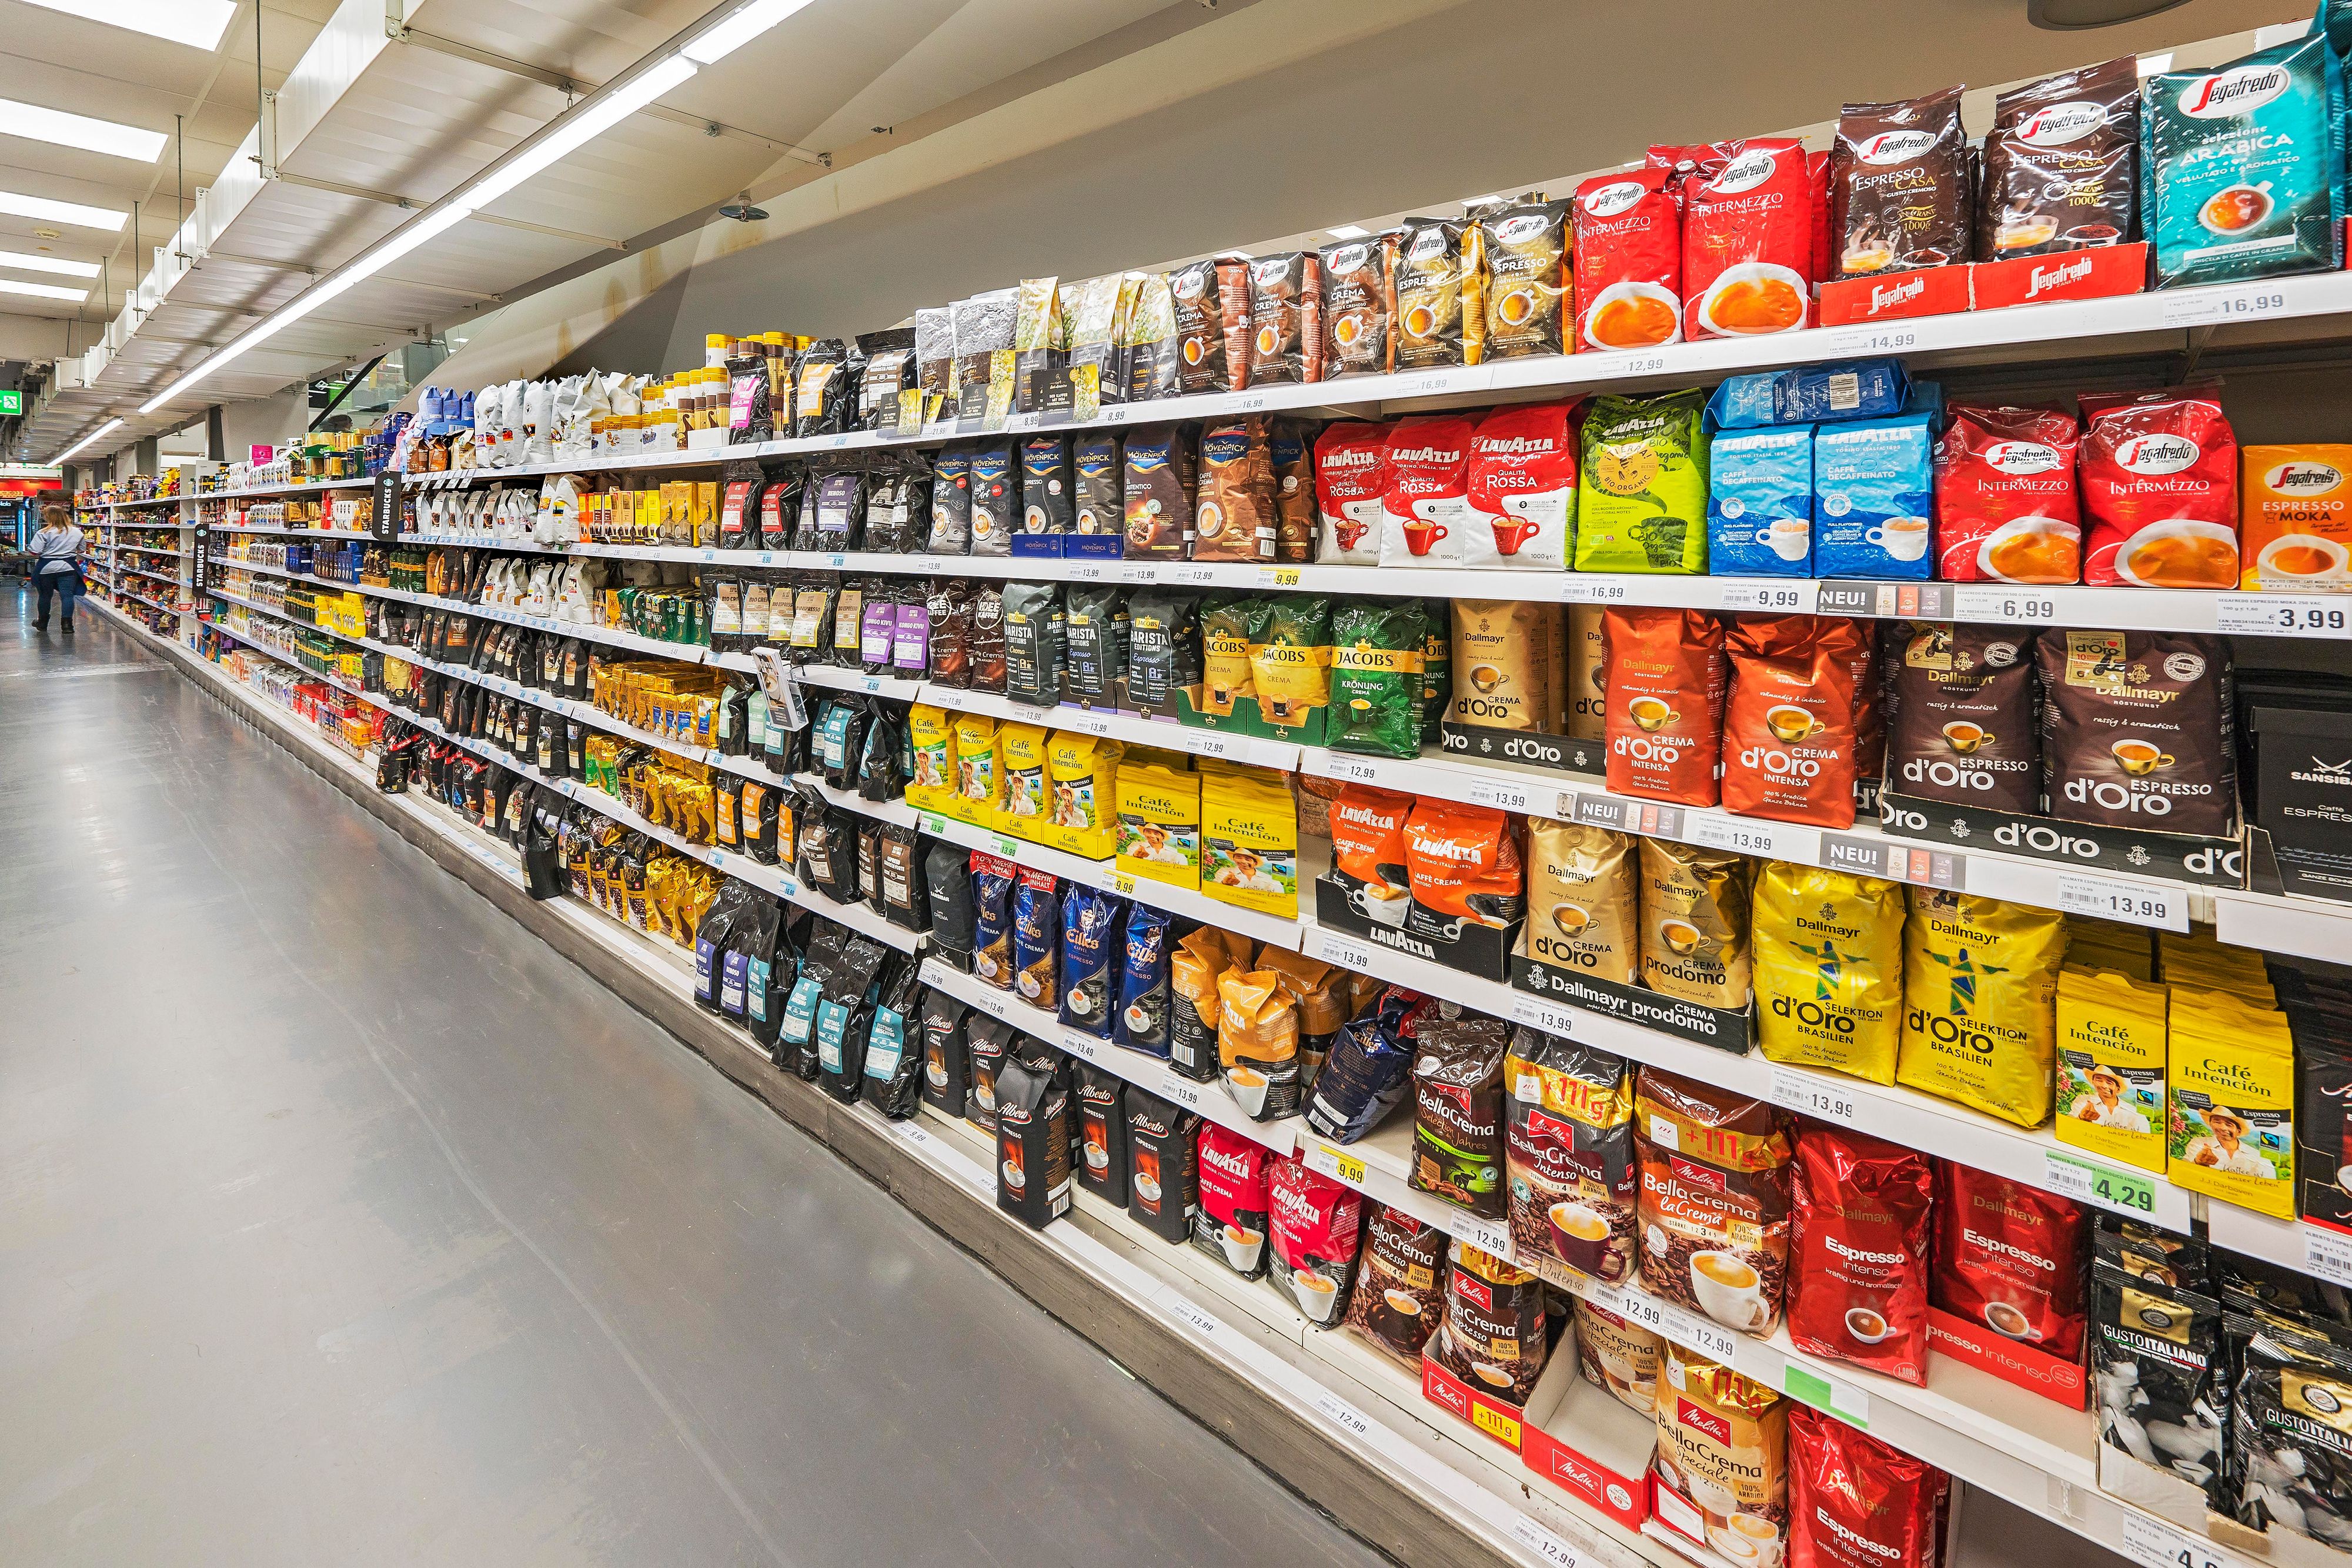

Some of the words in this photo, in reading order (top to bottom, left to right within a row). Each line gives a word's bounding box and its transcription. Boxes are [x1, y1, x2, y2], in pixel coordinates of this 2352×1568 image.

[2190, 71, 2277, 113] Segafredo
[2230, 92, 2263, 102] ZANETTI
[2202, 125, 2267, 146] selezione
[1863, 134, 1932, 163] Segafredo
[1893, 146, 1919, 155] ZANETTI
[2179, 133, 2294, 167] ARABICA
[2175, 168, 2228, 185] VELLUTATO
[2230, 166, 2236, 175] E
[2240, 156, 2300, 172] AROMATICO
[1855, 168, 1925, 191] ESPRESSO
[1895, 176, 1935, 189] CASA
[1909, 186, 1937, 194] CREMOSO
[1698, 193, 1784, 217] INTERMEZZO
[1903, 221, 1931, 232] 1000g
[1331, 286, 1366, 301] CREMA
[2222, 295, 2284, 313] 16,99
[1871, 334, 1916, 347] 14,99
[1421, 379, 1447, 390] 16,99
[1108, 412, 1124, 420] 8,99
[1607, 417, 1665, 437] LAVAZZA
[1828, 427, 1913, 444] LAVAZZA
[1479, 437, 1554, 453] LAVAZZA
[1024, 452, 1059, 462] MÖVENPICK
[1127, 448, 1167, 459] MÖVENPICK
[2124, 441, 2190, 465] Segafredo
[1486, 474, 1538, 487] ROSSA
[1604, 474, 1651, 490] BIO-ORGANIC
[1828, 471, 1896, 480] DECAFFEINATO
[2110, 480, 2210, 494] INTERMEZZO
[382, 488, 392, 534] STARBUCKS
[2263, 501, 2344, 511] ESPRESSO
[2279, 511, 2331, 521] MOKA
[196, 544, 205, 588] STARBUCKS
[833, 558, 844, 566] 9,90
[1193, 571, 1212, 582] 13,99
[1275, 574, 1297, 586] 9,99
[1591, 587, 1623, 597] 16,99
[1758, 591, 1799, 606] 9,99
[1820, 591, 1866, 605] NEU!
[979, 602, 1000, 610] IDEE
[2003, 600, 2053, 619] 6,99
[2280, 609, 2344, 630] 3,99
[1005, 625, 1033, 638] BARISTA
[1010, 646, 1025, 654] Crema
[1133, 653, 1160, 663] Espresso
[1337, 653, 1393, 666] JACOBS
[1623, 658, 1675, 673] Dallmayr
[2174, 663, 2200, 671] BARISTA
[1341, 680, 1384, 691] KRÖNUNG
[1928, 669, 1995, 687] Dallmayr
[868, 682, 879, 691] 6,50
[1622, 684, 1649, 693] vollmundig
[948, 697, 961, 706] 11,99
[2093, 717, 2118, 727] rassig
[2130, 721, 2180, 730] aromatisch
[1011, 739, 1030, 750] Café
[1652, 735, 1696, 747] CREMA
[1005, 747, 1034, 760] Intención
[1614, 735, 1679, 764] d'Oro
[1350, 767, 1375, 778] 12,99
[1631, 760, 1671, 773] INTENSA
[2130, 779, 2211, 795] ESPRESSO
[1138, 795, 1171, 809] Café
[2063, 780, 2171, 816] d'Oro
[1125, 800, 1184, 818] Intención
[1058, 840, 1083, 851] Intención
[1063, 833, 1077, 844] Café
[1733, 831, 1772, 852] 13,99
[1001, 845, 1017, 857] 13,99
[1830, 844, 1877, 865] NEU!
[1837, 863, 1876, 873] dallmayr.com/doro
[1115, 880, 1134, 893] 9,99
[1434, 877, 1462, 887] CREMA
[2109, 895, 2167, 919] 13,99
[1066, 929, 1098, 949] Eilles
[1369, 928, 1435, 959] LAVAZZA
[1811, 932, 1846, 942] RÖSTKUNST
[1067, 953, 1094, 965] ESPRESSO
[1682, 959, 1725, 971] CREMA
[930, 974, 943, 984] 15,99
[1646, 958, 1726, 985] prodomo
[990, 1002, 1004, 1014] 13,49
[1552, 976, 1628, 1010] Dallmayr
[1631, 1001, 1717, 1035] prodomo
[1825, 1002, 1883, 1019] SELEKTION
[1541, 1012, 1572, 1032] 13,99
[1798, 1024, 1854, 1045] BRASILIEN
[2086, 1021, 2129, 1041] Café
[2070, 1027, 2147, 1057] Intención
[2121, 1068, 2154, 1076] Espresso
[1083, 1106, 1104, 1118] ESPRESSO
[1419, 1088, 1495, 1136] BellaCrema
[1812, 1093, 1852, 1118] 13,99
[1129, 1113, 1165, 1134] Alberto
[1421, 1107, 1455, 1134] Selection
[910, 1131, 926, 1141] 9,99
[1452, 1131, 1487, 1150] Jahres
[2094, 1134, 2130, 1149] Darboven
[1201, 1146, 1250, 1178] LAVAZZA
[1532, 1159, 1576, 1179] Intenso
[2046, 1153, 2070, 1164] DARBOVEN
[2072, 1161, 2096, 1172] INTENCION
[2097, 1168, 2123, 1179] ECOLOGICO
[2124, 1177, 2146, 1186] ESPRESS
[1338, 1164, 1364, 1183] 9,99
[1678, 1165, 1718, 1188] Melitta
[1643, 1172, 1758, 1221] BellaCrema
[2097, 1179, 2152, 1212] 4,29
[1660, 1198, 1723, 1225] laCrema
[1733, 1223, 1753, 1234] 100%
[1731, 1232, 1759, 1245] ARABICA
[1825, 1235, 1905, 1264] Espresso
[1843, 1260, 1889, 1276] intenso
[1825, 1268, 1846, 1280] kräftig
[1847, 1276, 1863, 1285] und
[1865, 1281, 1903, 1289] aromatisch
[1696, 1326, 1733, 1356] 12,99
[1434, 1383, 1465, 1406] Melitta
[1339, 1411, 1367, 1434] 12,99
[1477, 1410, 1502, 1431] +111
[1658, 1416, 1763, 1477] BellaCrema
[1675, 1445, 1729, 1484] Speciale
